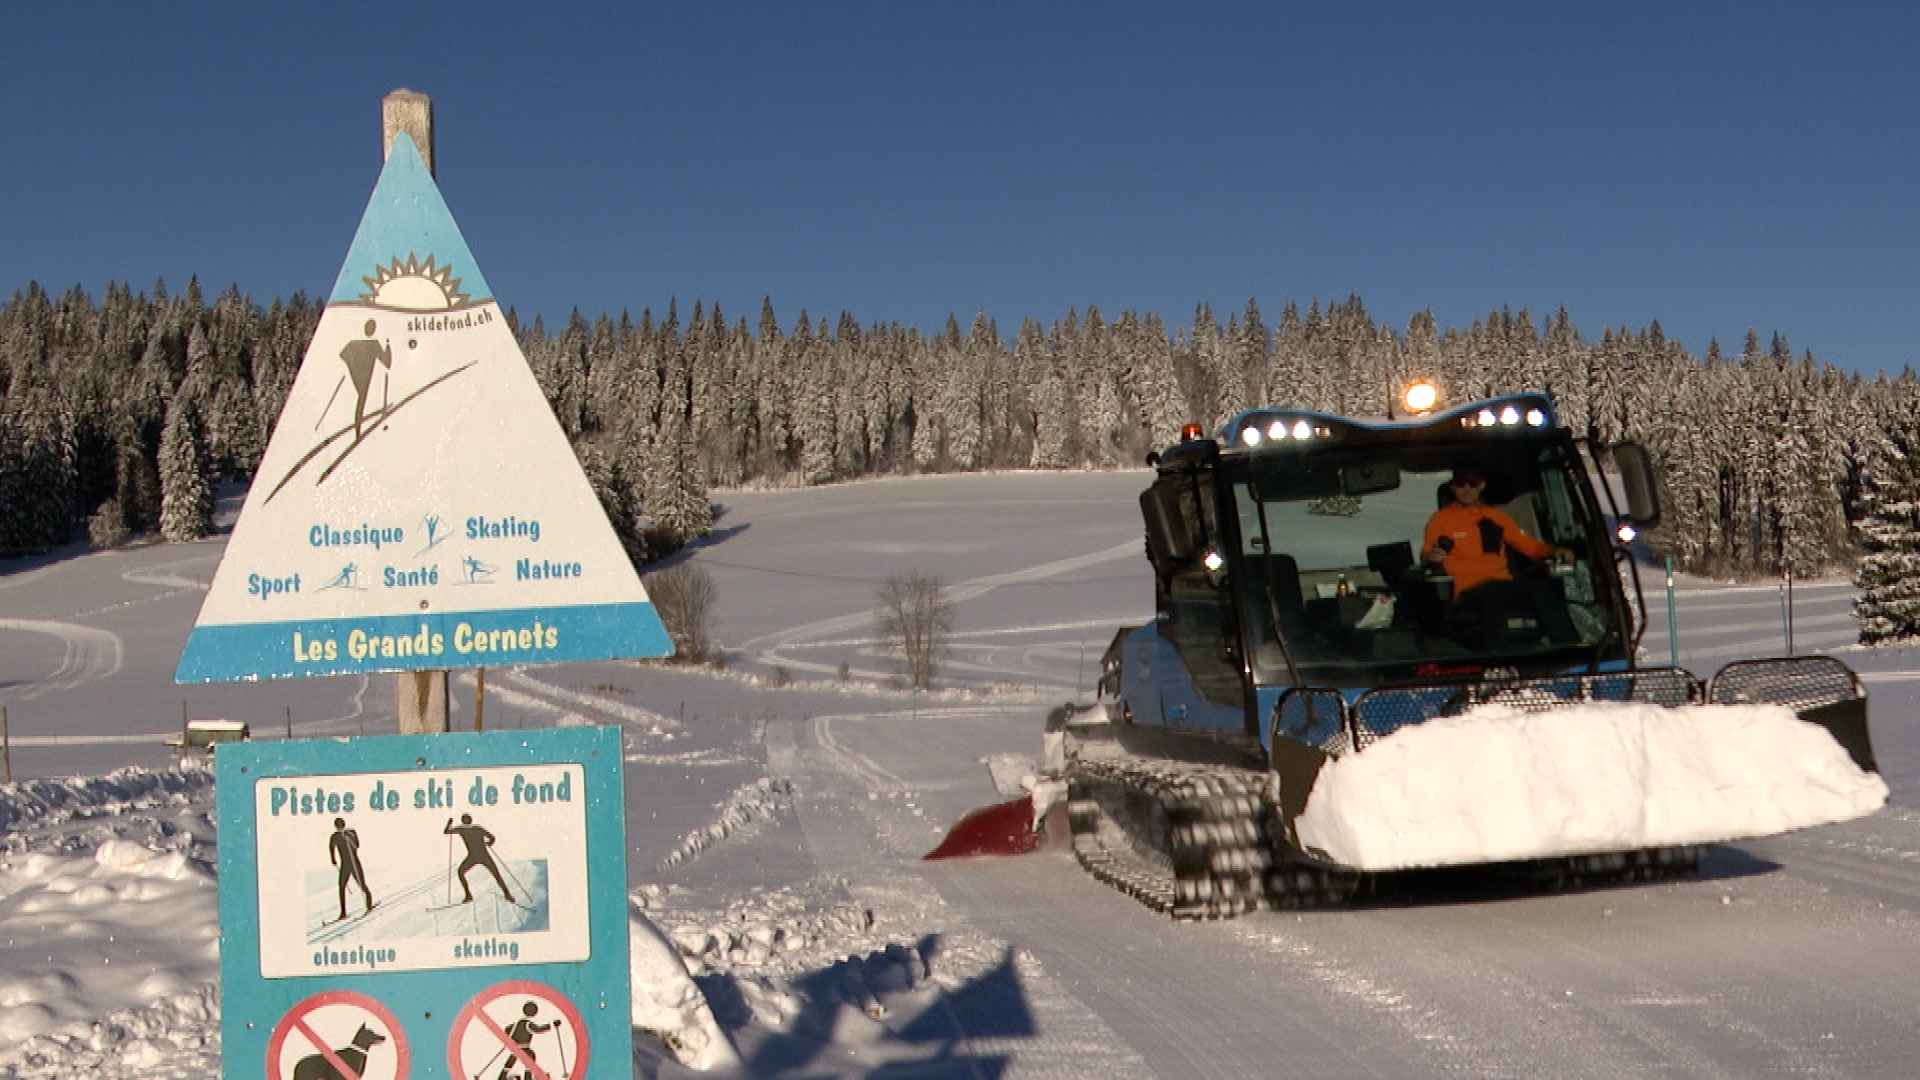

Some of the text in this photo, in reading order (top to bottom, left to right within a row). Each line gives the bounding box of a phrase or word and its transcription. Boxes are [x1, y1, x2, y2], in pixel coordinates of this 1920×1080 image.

[407, 308, 492, 331] skidefond.ch
[309, 524, 404, 549] Classique
[466, 516, 541, 542] Skating
[383, 564, 439, 588] Santé
[516, 558, 582, 581] Nature
[248, 573, 301, 599] Sport
[293, 622, 559, 662] Les Grands Cernets
[271, 771, 572, 816] Pistes de ski de fond
[313, 945, 396, 968] classique
[454, 938, 519, 960] skating
